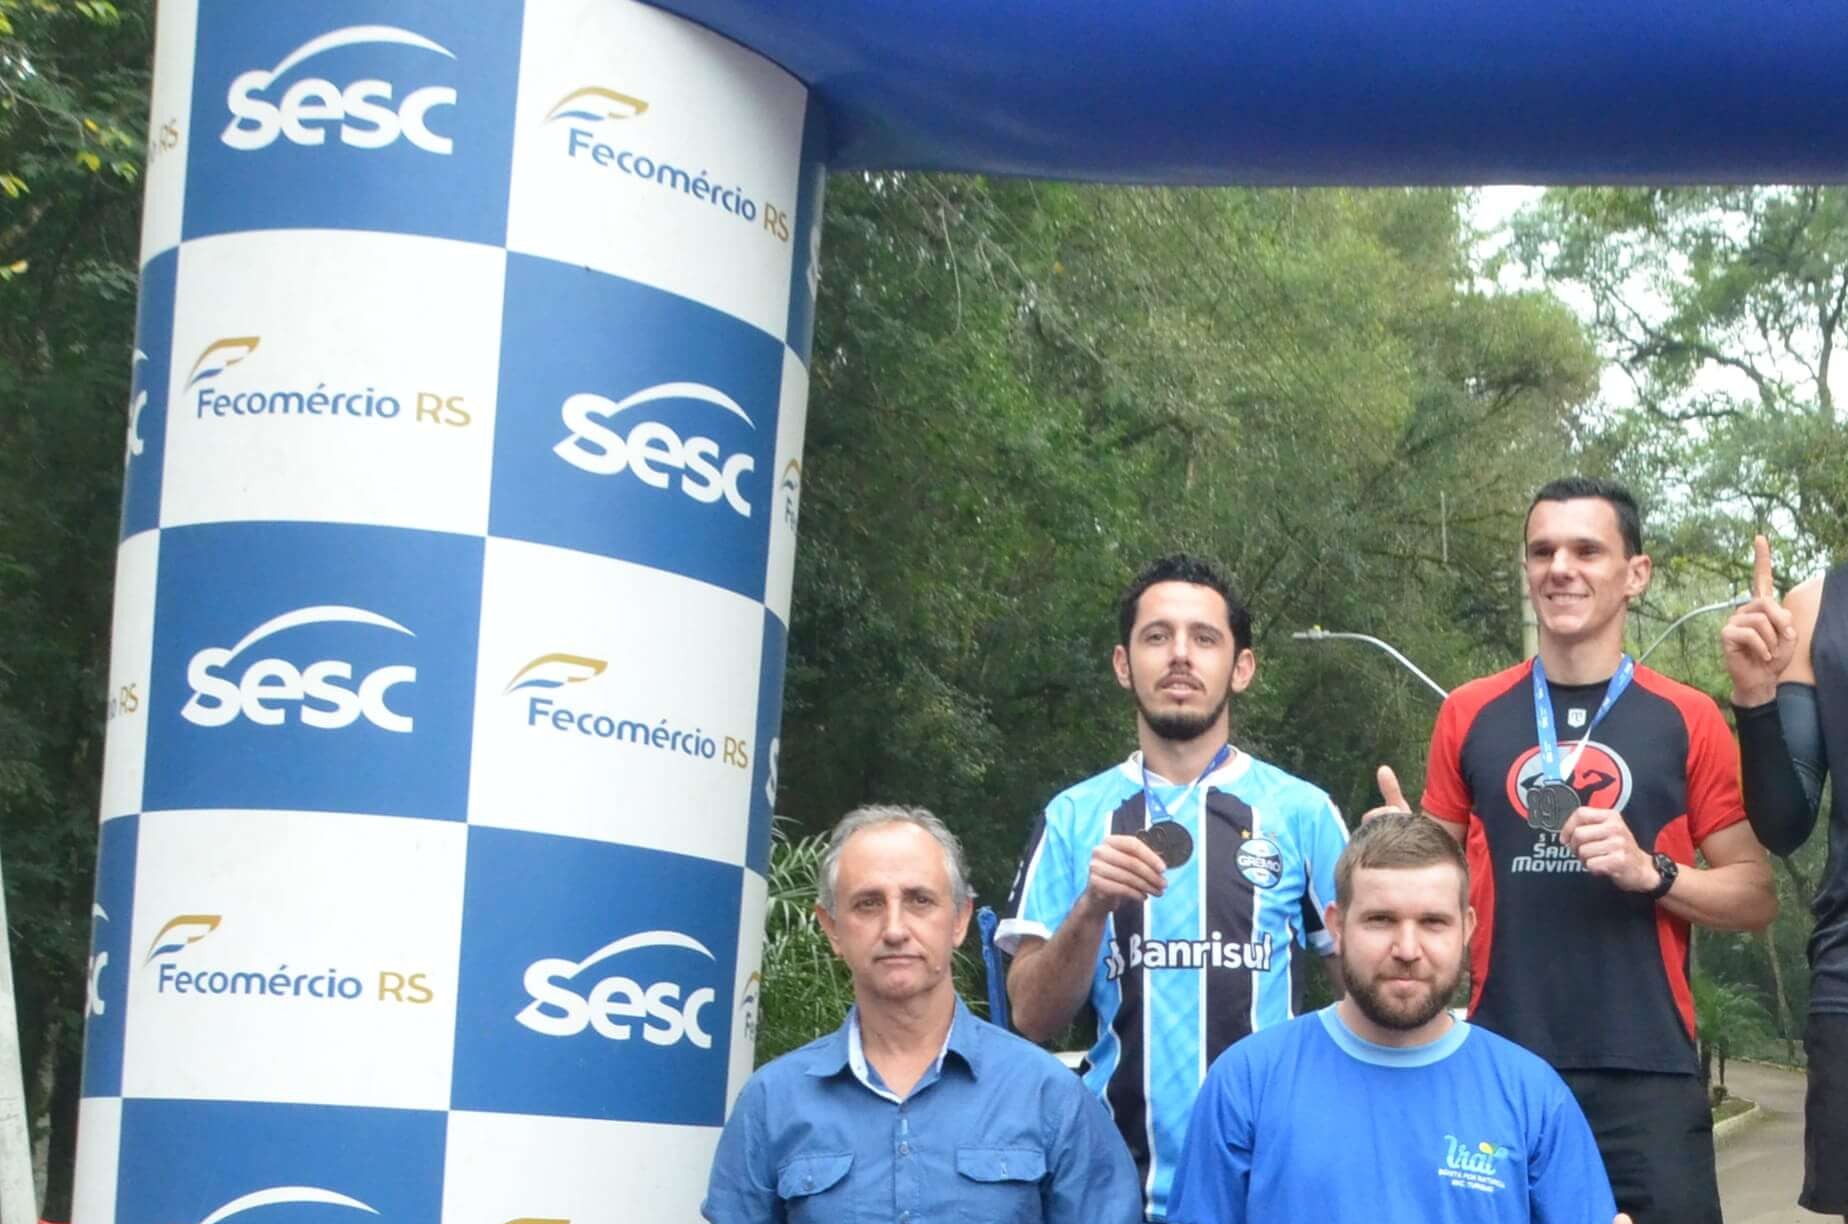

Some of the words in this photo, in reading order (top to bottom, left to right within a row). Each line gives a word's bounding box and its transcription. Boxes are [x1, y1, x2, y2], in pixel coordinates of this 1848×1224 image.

[567, 128, 757, 221] Fecomércio
[764, 202, 790, 244] RS
[197, 383, 400, 420] Fecomércio
[415, 392, 471, 427] RS
[528, 697, 716, 761] Fecomércio
[723, 735, 749, 769] RS
[1129, 931, 1271, 971] Banrisul
[158, 962, 362, 1000] Fecomércio
[379, 972, 433, 1004] RS
